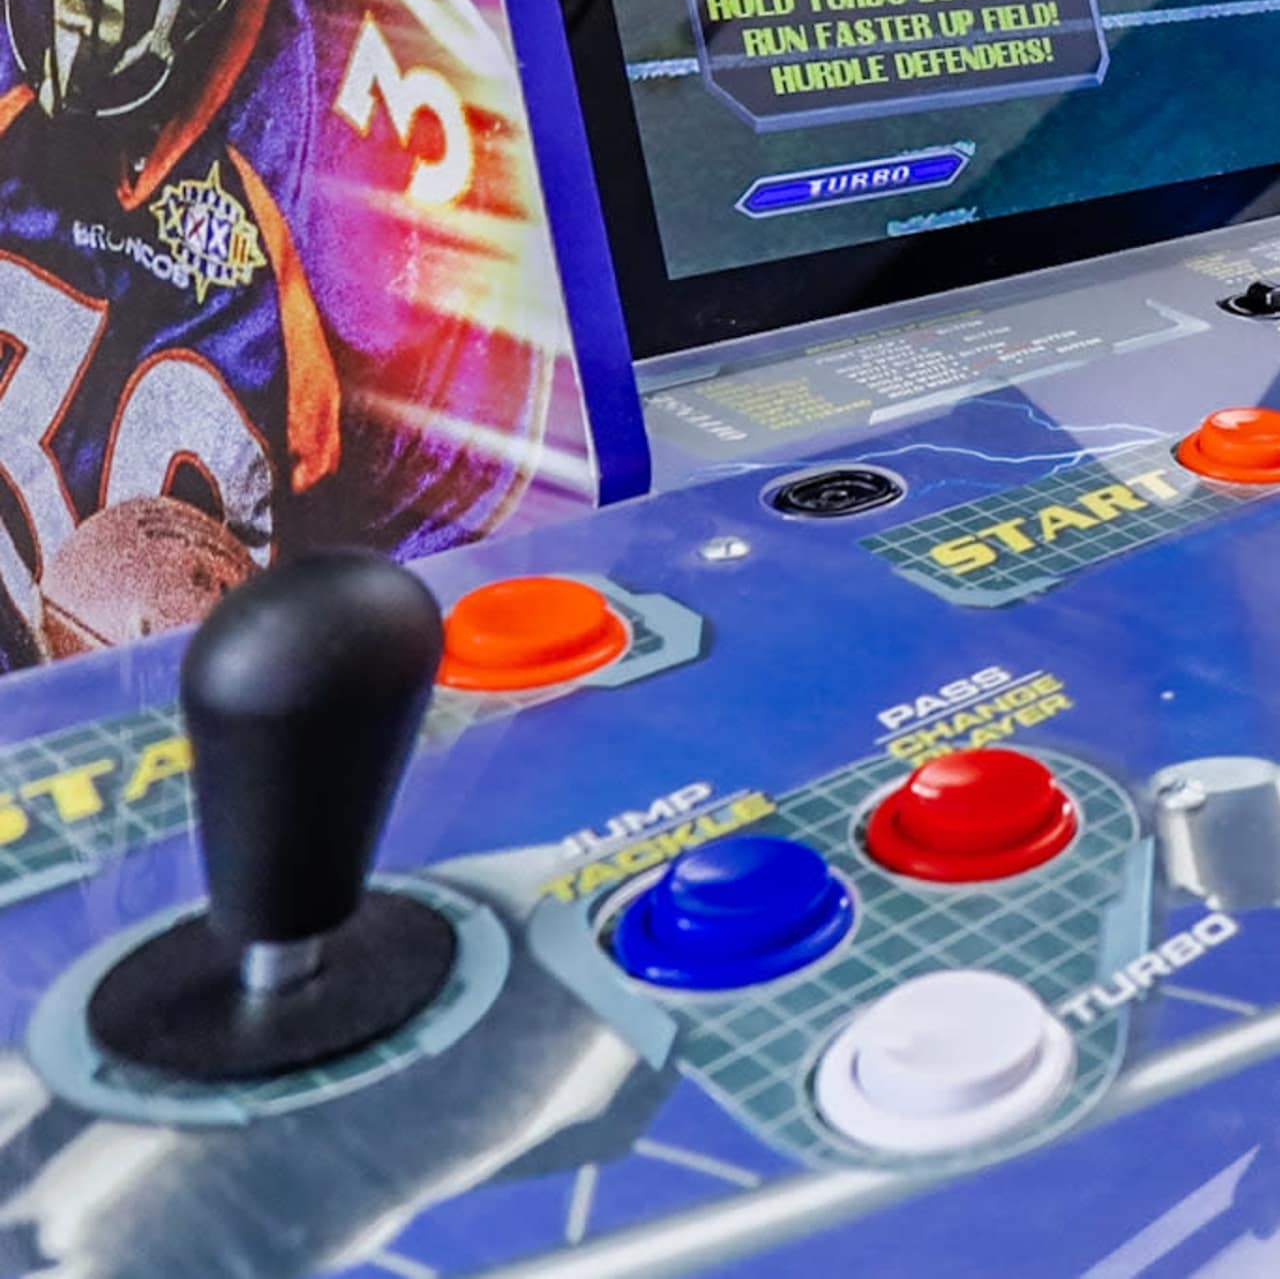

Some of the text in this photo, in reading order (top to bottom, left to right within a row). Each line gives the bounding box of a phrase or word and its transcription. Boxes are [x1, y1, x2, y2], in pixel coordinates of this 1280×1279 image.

[742, 1, 1060, 58] RUN FASTER UP FIELD!
[770, 38, 1054, 96] HURDLE DEFENDERS!
[808, 165, 911, 198] TURBO
[72, 220, 190, 289] BRONCOS
[930, 469, 1180, 576] START
[877, 666, 1011, 729] PASS
[889, 673, 1064, 758] CHANGE
[537, 790, 776, 902] TACKLE
[561, 781, 711, 858] JUMP
[1055, 912, 1239, 1024] TURBO
